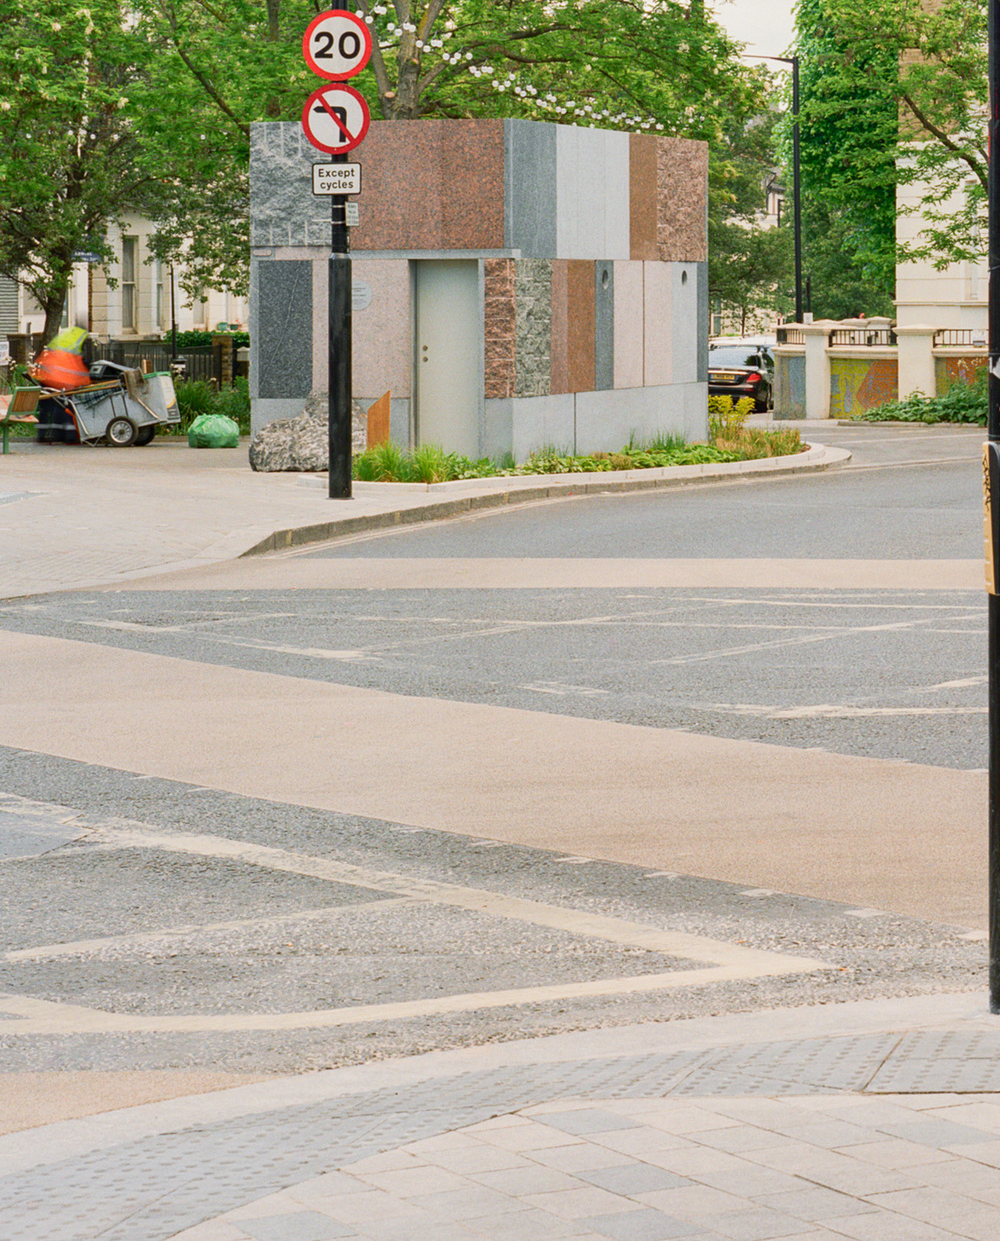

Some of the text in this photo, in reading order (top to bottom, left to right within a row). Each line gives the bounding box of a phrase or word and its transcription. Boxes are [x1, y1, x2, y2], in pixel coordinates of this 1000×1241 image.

[314, 31, 361, 59] 20
[318, 168, 355, 178] Except
[320, 180, 354, 191] cycles
